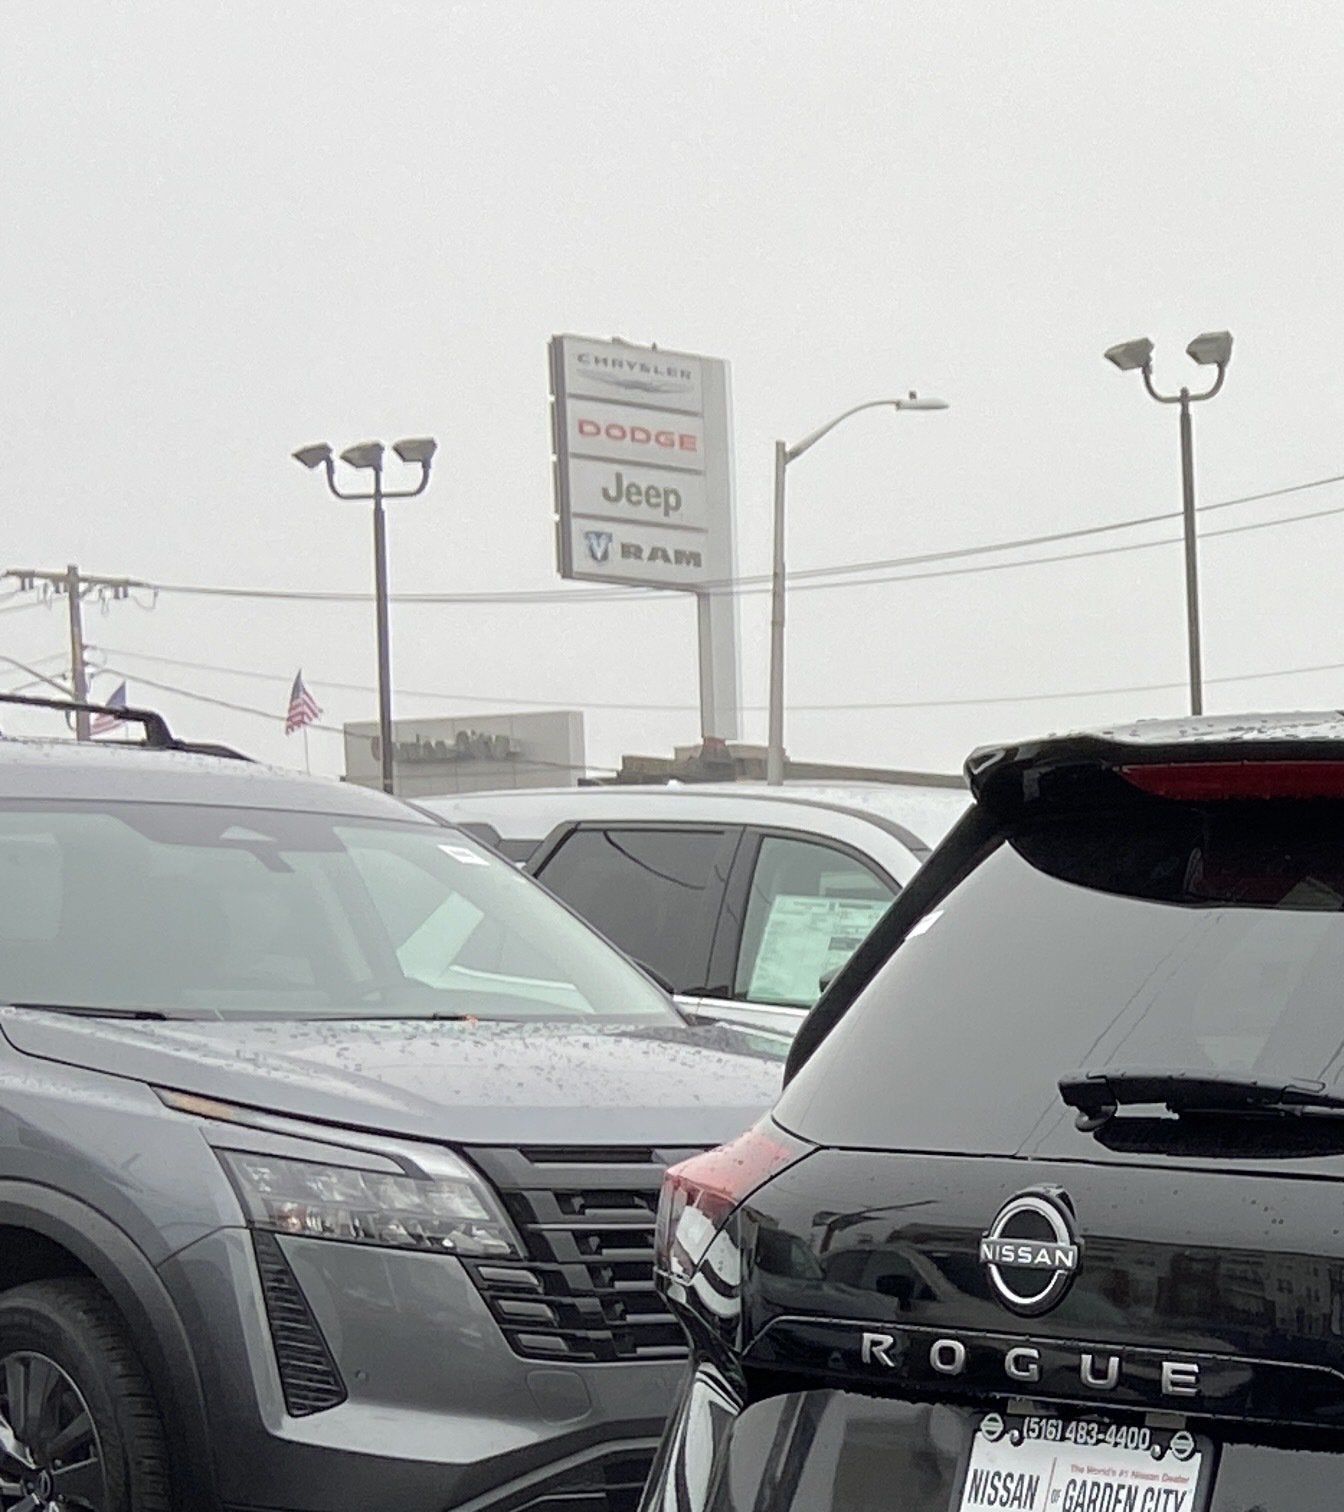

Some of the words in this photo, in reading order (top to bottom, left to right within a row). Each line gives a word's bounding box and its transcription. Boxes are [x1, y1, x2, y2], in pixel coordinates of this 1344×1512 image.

[576, 353, 692, 380] CHRYSLER
[577, 418, 698, 452] DODGE
[601, 472, 682, 517] Jeep
[620, 542, 702, 569] RAM
[980, 1241, 1075, 1269] NISSAN
[861, 1332, 1200, 1398] ROGUE
[1024, 1417, 1062, 1440] (516)
[1065, 1421, 1151, 1450] 483-4400
[968, 1468, 1040, 1511] NISSAN
